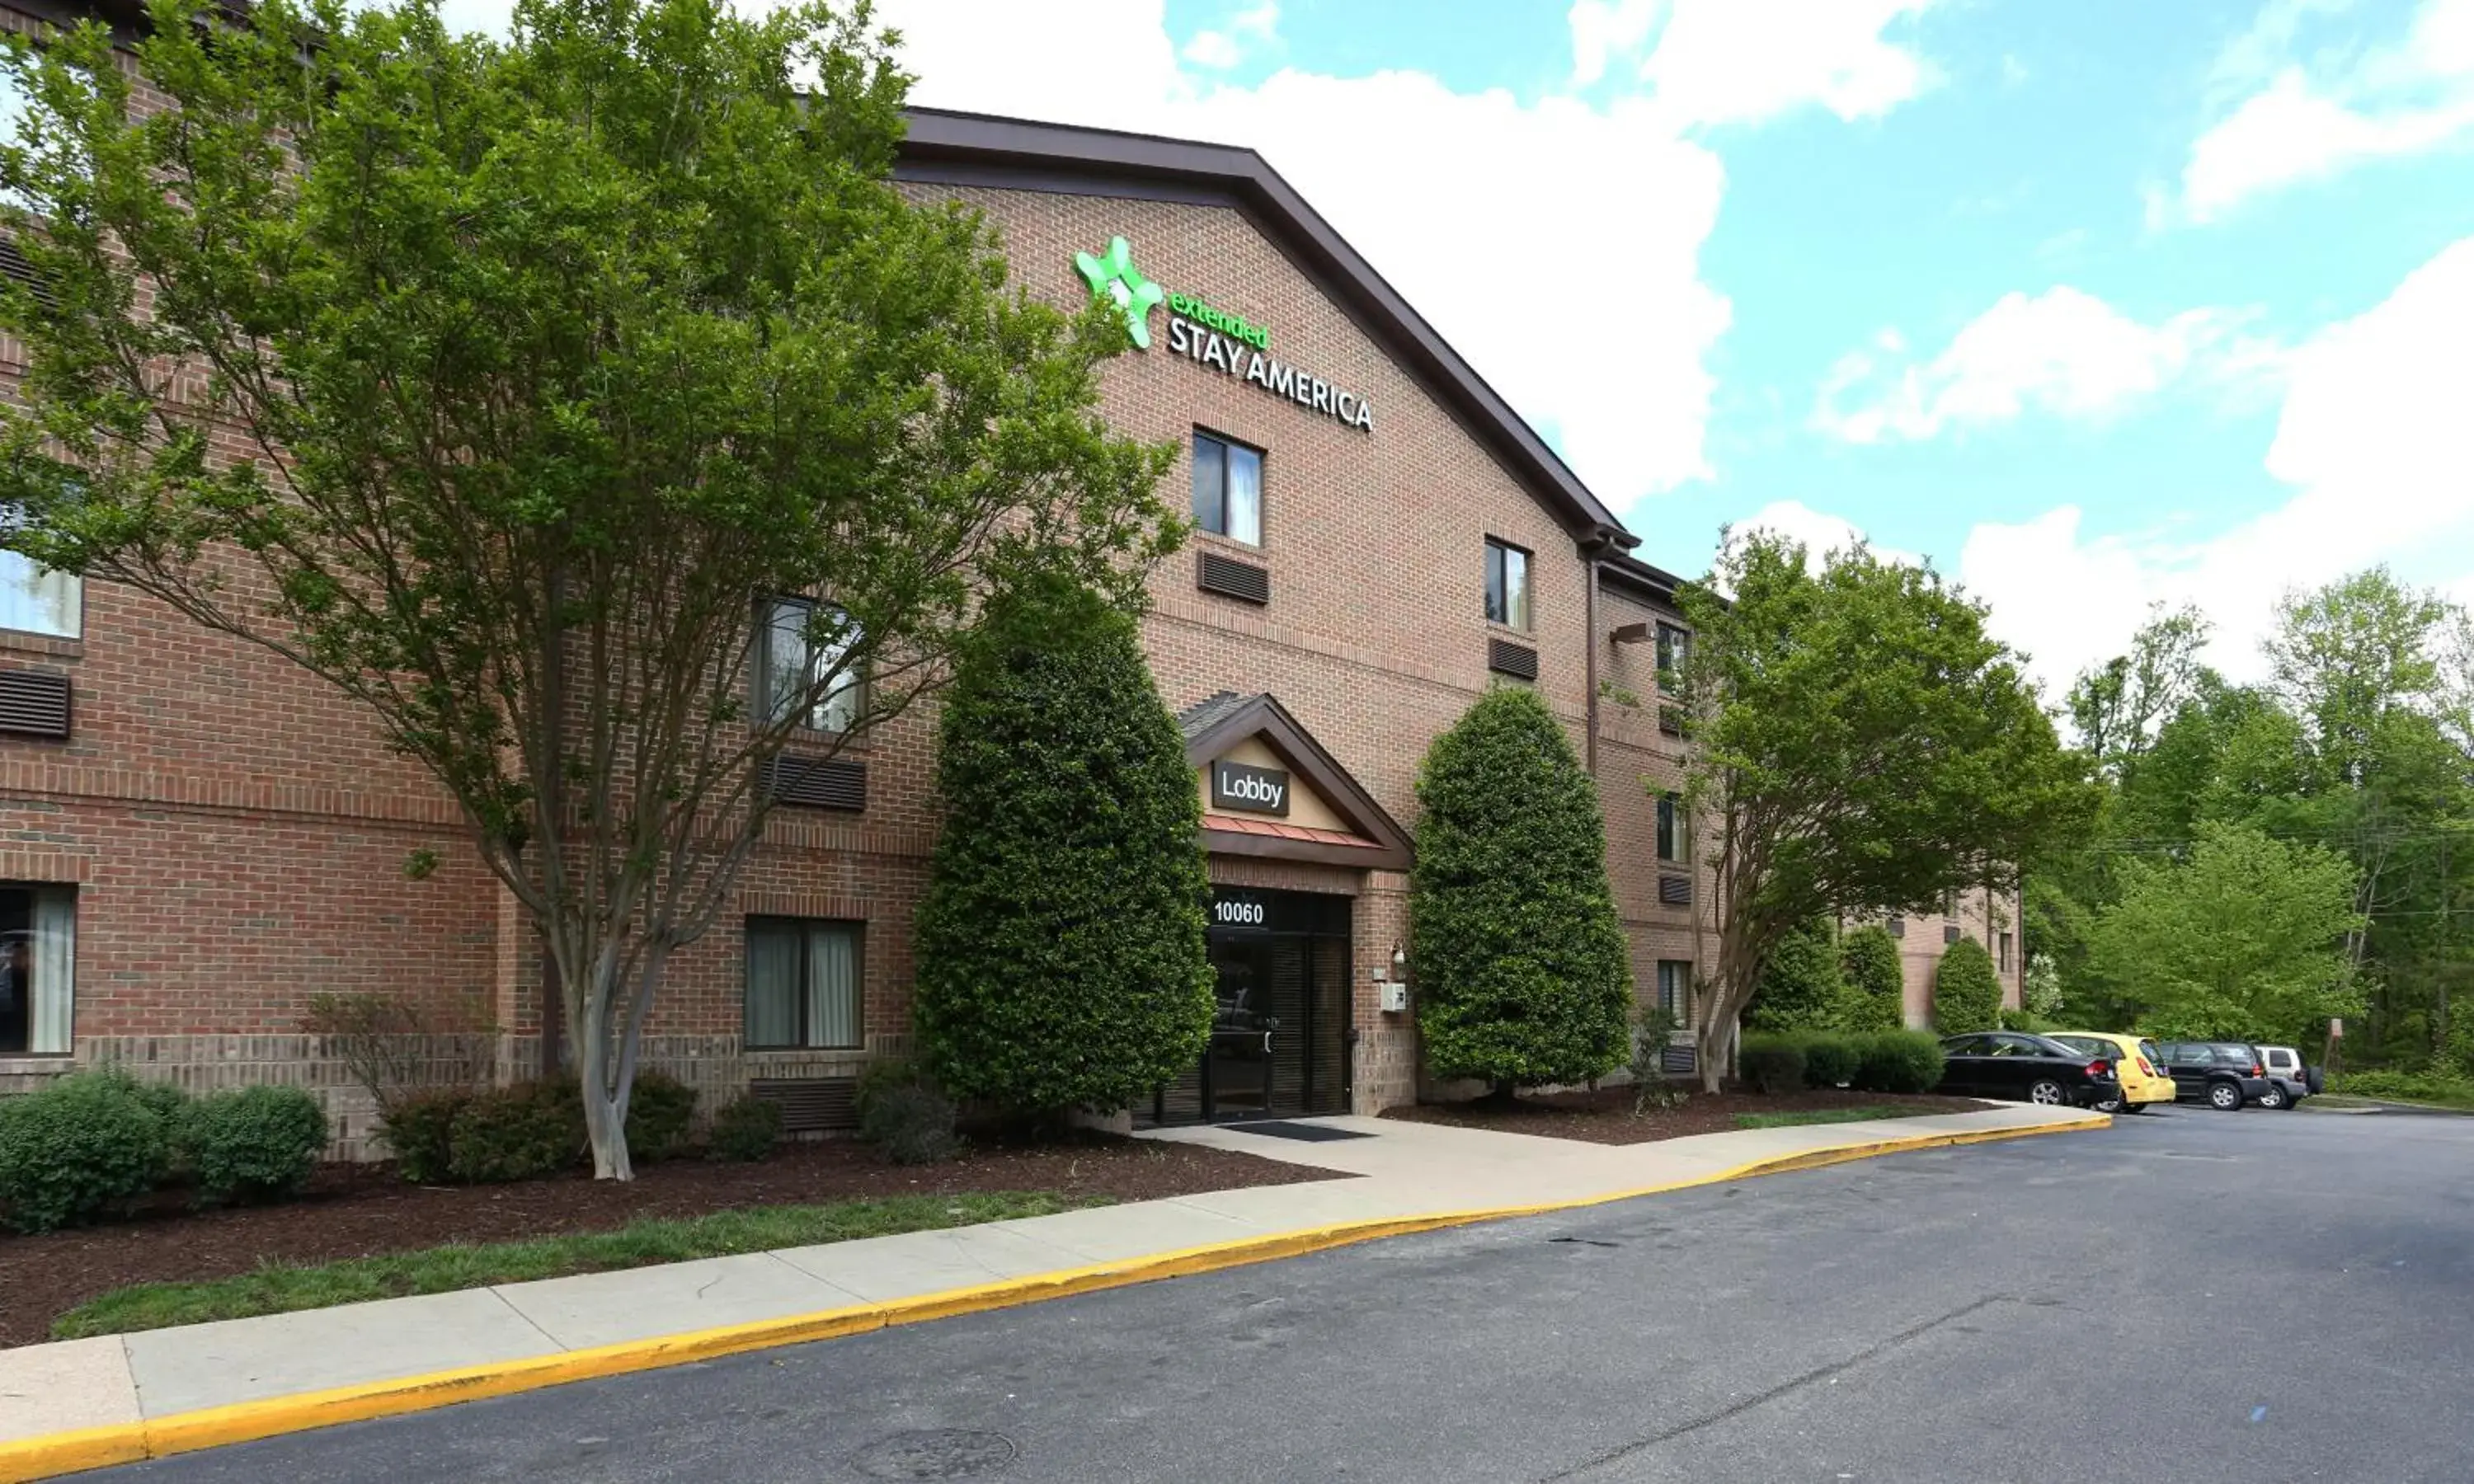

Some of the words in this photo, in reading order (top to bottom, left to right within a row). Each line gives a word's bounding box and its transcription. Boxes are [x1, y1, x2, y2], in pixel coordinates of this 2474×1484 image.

[1169, 292, 1268, 350] extended
[1169, 317, 1244, 374] STAY
[1247, 353, 1373, 431] AMERICA
[1222, 771, 1282, 808] Lobby
[1215, 901, 1263, 923] 10060
